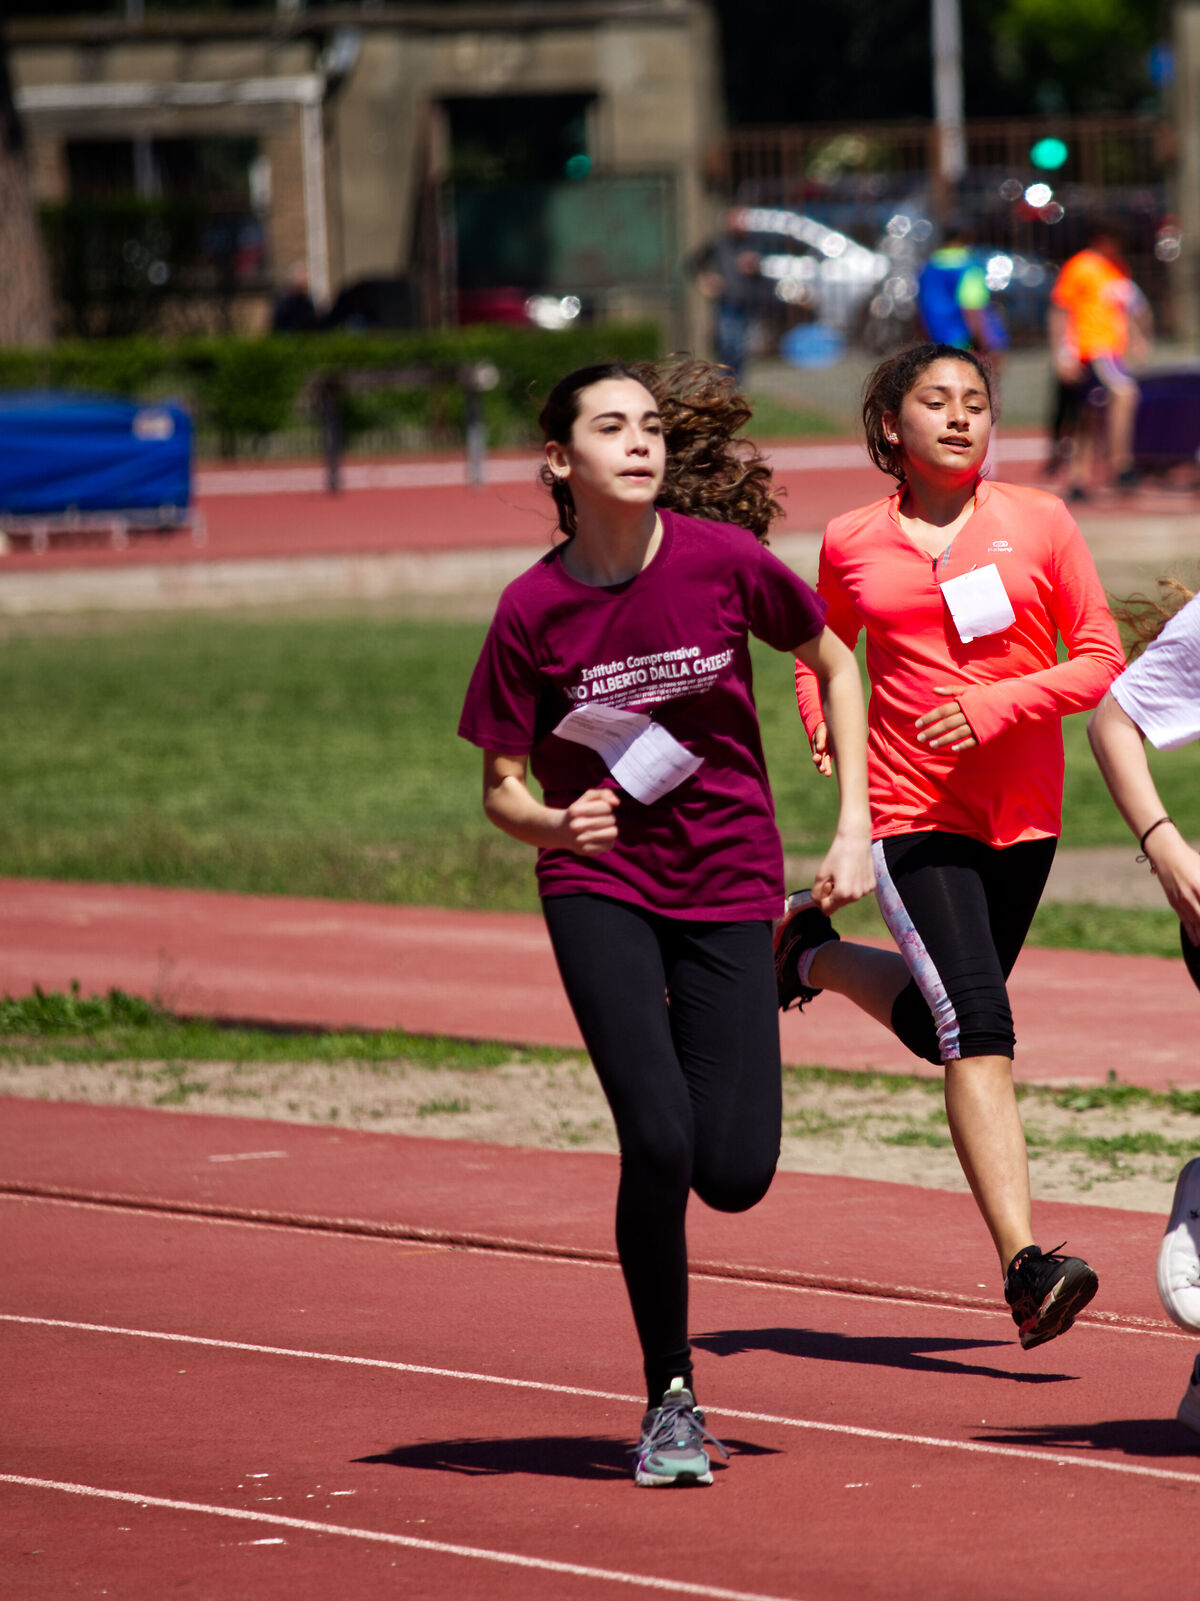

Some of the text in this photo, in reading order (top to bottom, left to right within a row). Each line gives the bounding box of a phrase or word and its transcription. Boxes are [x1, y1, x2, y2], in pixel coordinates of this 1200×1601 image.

[581, 646, 701, 682] Istituto Comprensivo
[592, 669, 648, 696] ALBERTO
[649, 662, 690, 681] DALLA
